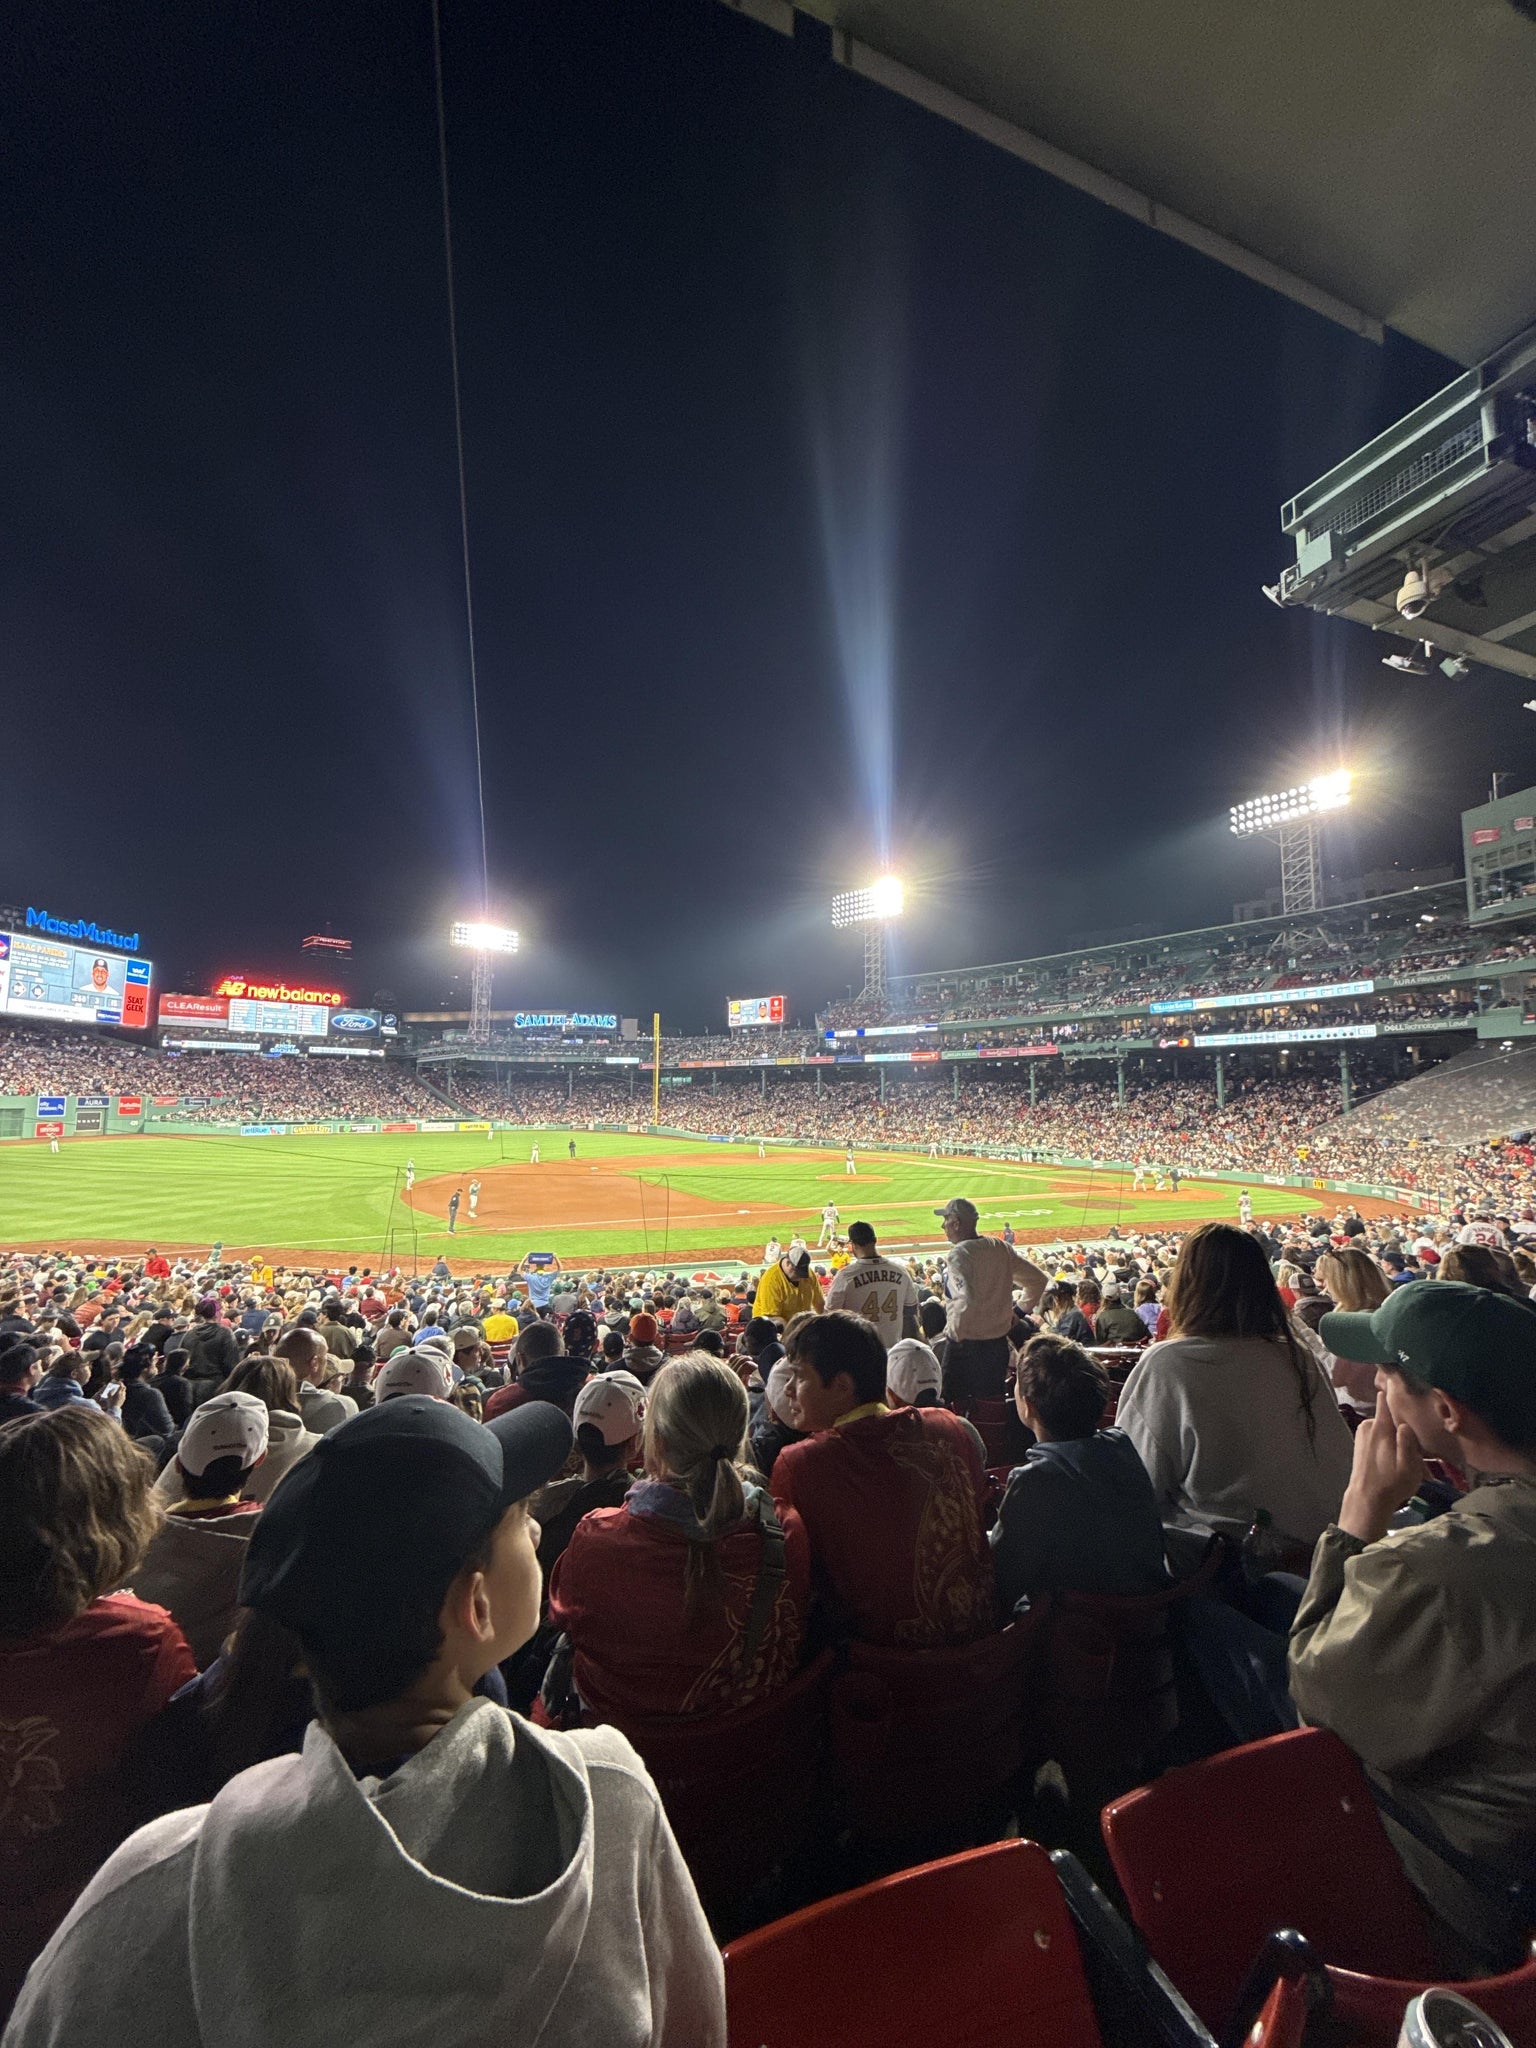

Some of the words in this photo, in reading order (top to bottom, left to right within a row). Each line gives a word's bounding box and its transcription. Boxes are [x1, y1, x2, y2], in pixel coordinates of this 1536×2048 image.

[26, 906, 139, 951] MassMutual
[127, 995, 144, 1005] SEAT
[166, 1001, 222, 1012] CLEAResult
[126, 1003, 144, 1013] GEEK
[339, 1015, 368, 1028] Ford
[514, 1012, 569, 1028] SAMUEL
[570, 1012, 617, 1028] ADAMS
[1449, 1019, 1469, 1028] Level
[1475, 1232, 1497, 1246] 24
[853, 1269, 903, 1289] ALVAREZ
[861, 1289, 899, 1322] 44
